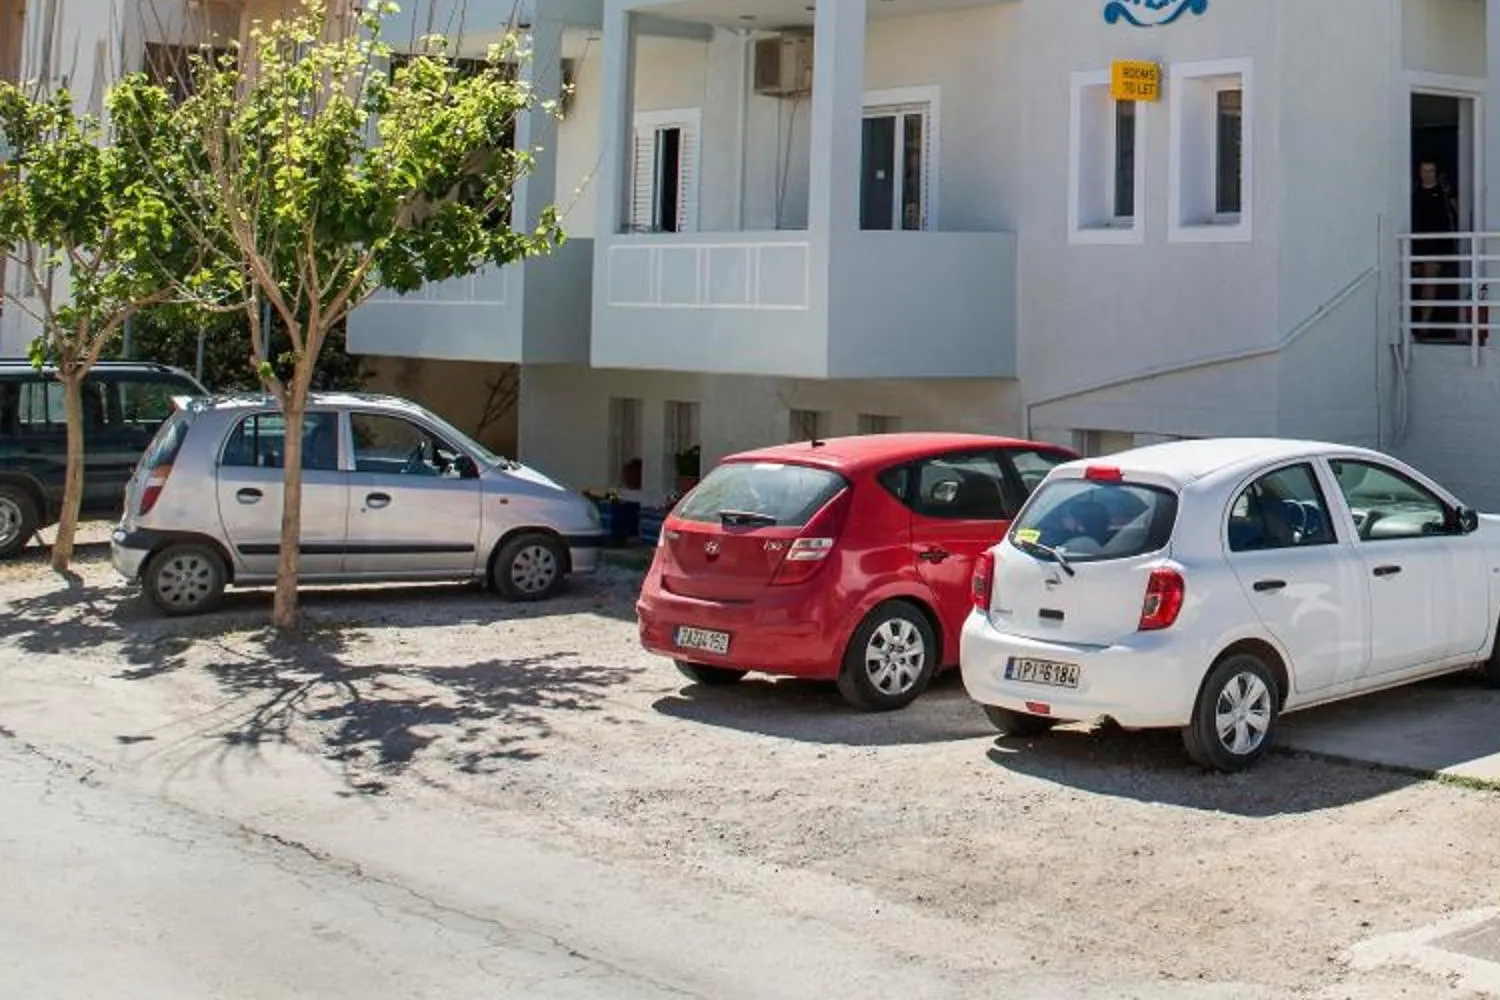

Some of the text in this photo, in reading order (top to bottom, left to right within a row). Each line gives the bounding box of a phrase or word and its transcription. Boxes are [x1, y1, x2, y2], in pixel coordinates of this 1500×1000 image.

[1122, 66, 1155, 81] ROOMS
[1123, 81, 1155, 96] TO LET
